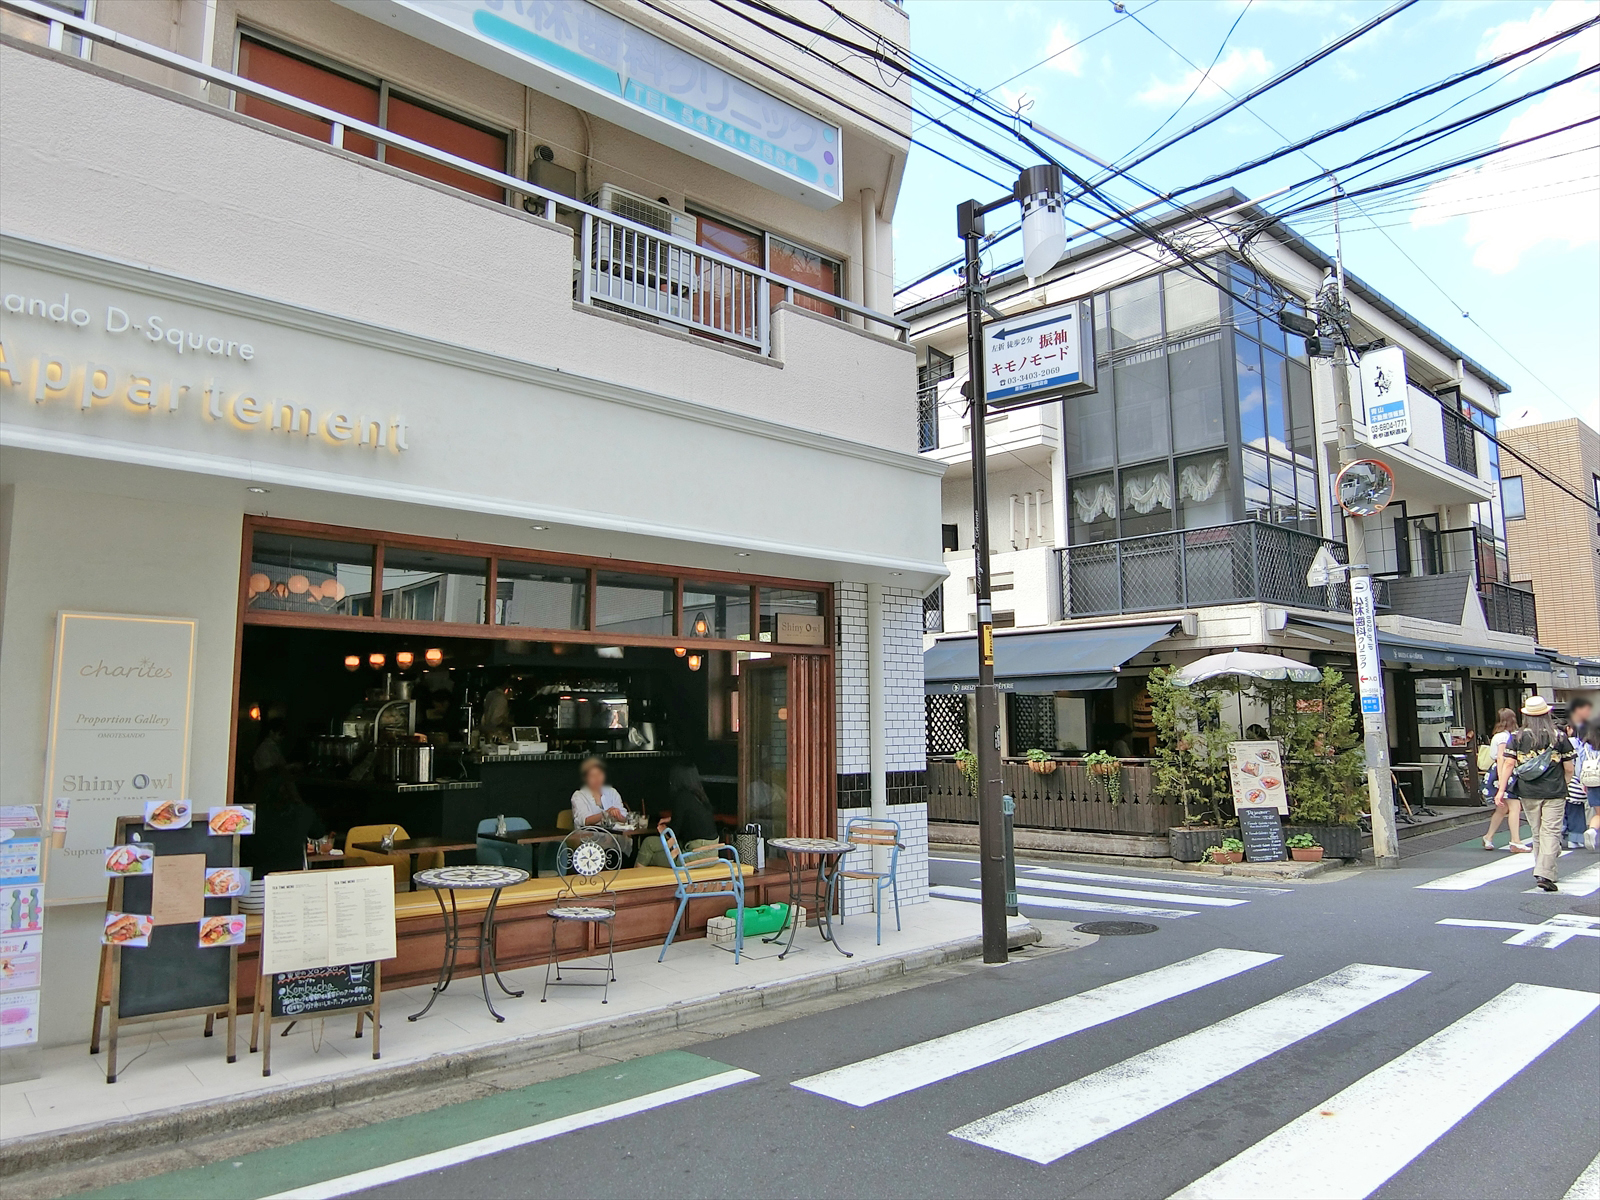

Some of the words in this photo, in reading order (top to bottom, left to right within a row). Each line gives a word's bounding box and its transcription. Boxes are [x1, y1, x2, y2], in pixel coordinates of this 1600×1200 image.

[630, 82, 678, 118] TEL
[0, 293, 91, 328] ando
[106, 307, 256, 361] D-Square
[991, 342, 1005, 353] 左折
[1006, 336, 1034, 349] 徒歩2分
[1038, 329, 1068, 349] 振袖
[991, 346, 1070, 377] キモノモード
[1007, 366, 1061, 385] 03-3403-2069
[781, 622, 804, 634] Shiny
[805, 623, 821, 633] Owl
[79, 657, 173, 679] charites
[76, 714, 131, 726] Proportion
[134, 714, 170, 727] Gallery
[62, 775, 125, 795] Shiny
[132, 773, 173, 790] Owl
[286, 979, 334, 996] Kombucha
